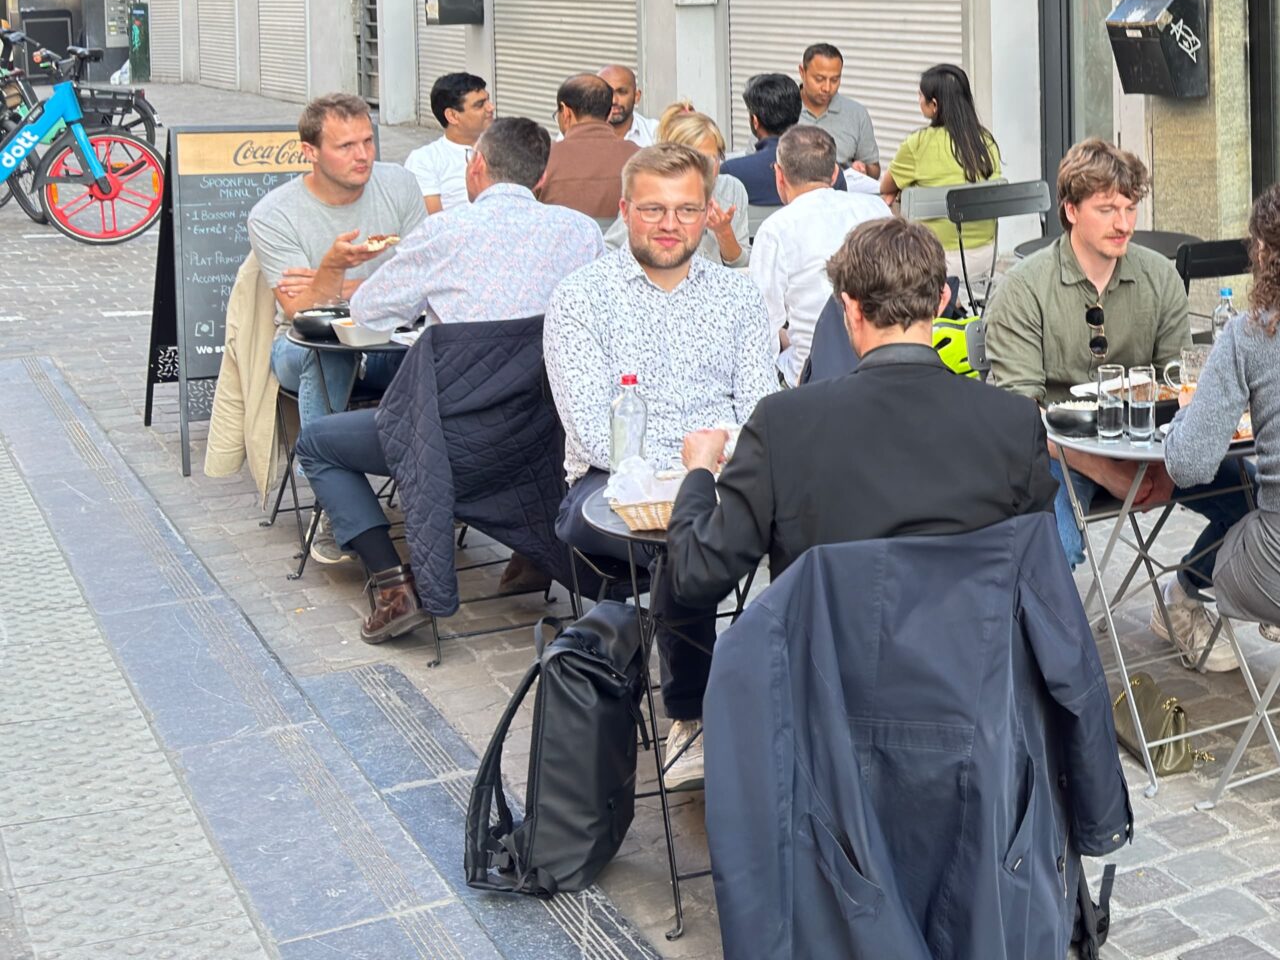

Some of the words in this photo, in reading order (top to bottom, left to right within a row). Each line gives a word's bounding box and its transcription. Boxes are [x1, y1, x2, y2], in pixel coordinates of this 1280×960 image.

[2, 130, 40, 168] dott
[262, 173, 278, 186] OF
[196, 345, 214, 356] We
